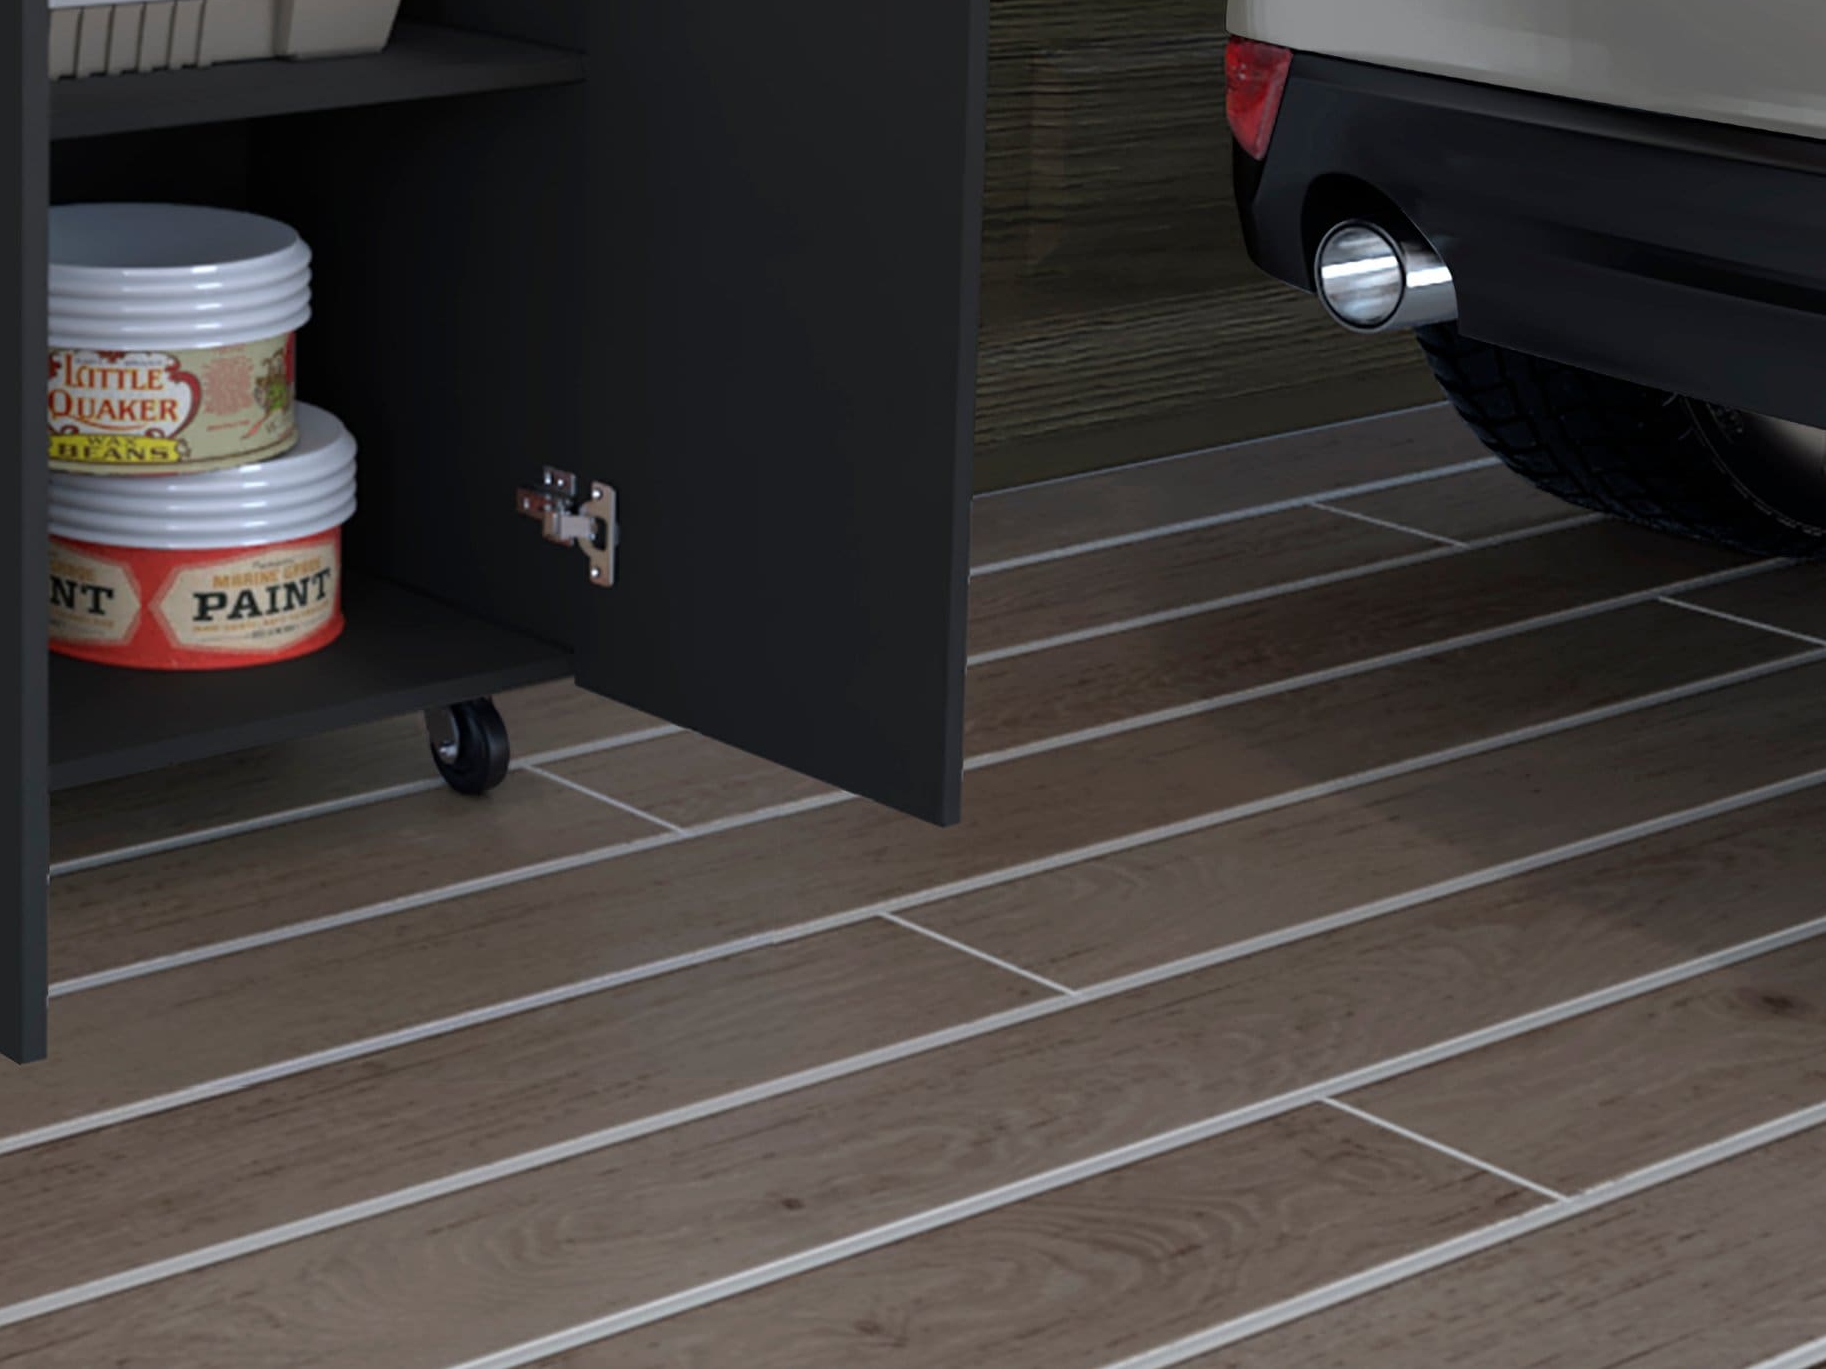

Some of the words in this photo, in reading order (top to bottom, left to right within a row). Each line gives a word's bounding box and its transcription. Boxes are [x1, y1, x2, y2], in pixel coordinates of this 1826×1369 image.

[63, 353, 164, 391] LITTLE
[48, 389, 179, 427] QUAKER
[57, 443, 169, 462] BEANS
[191, 567, 332, 622] PAINT
